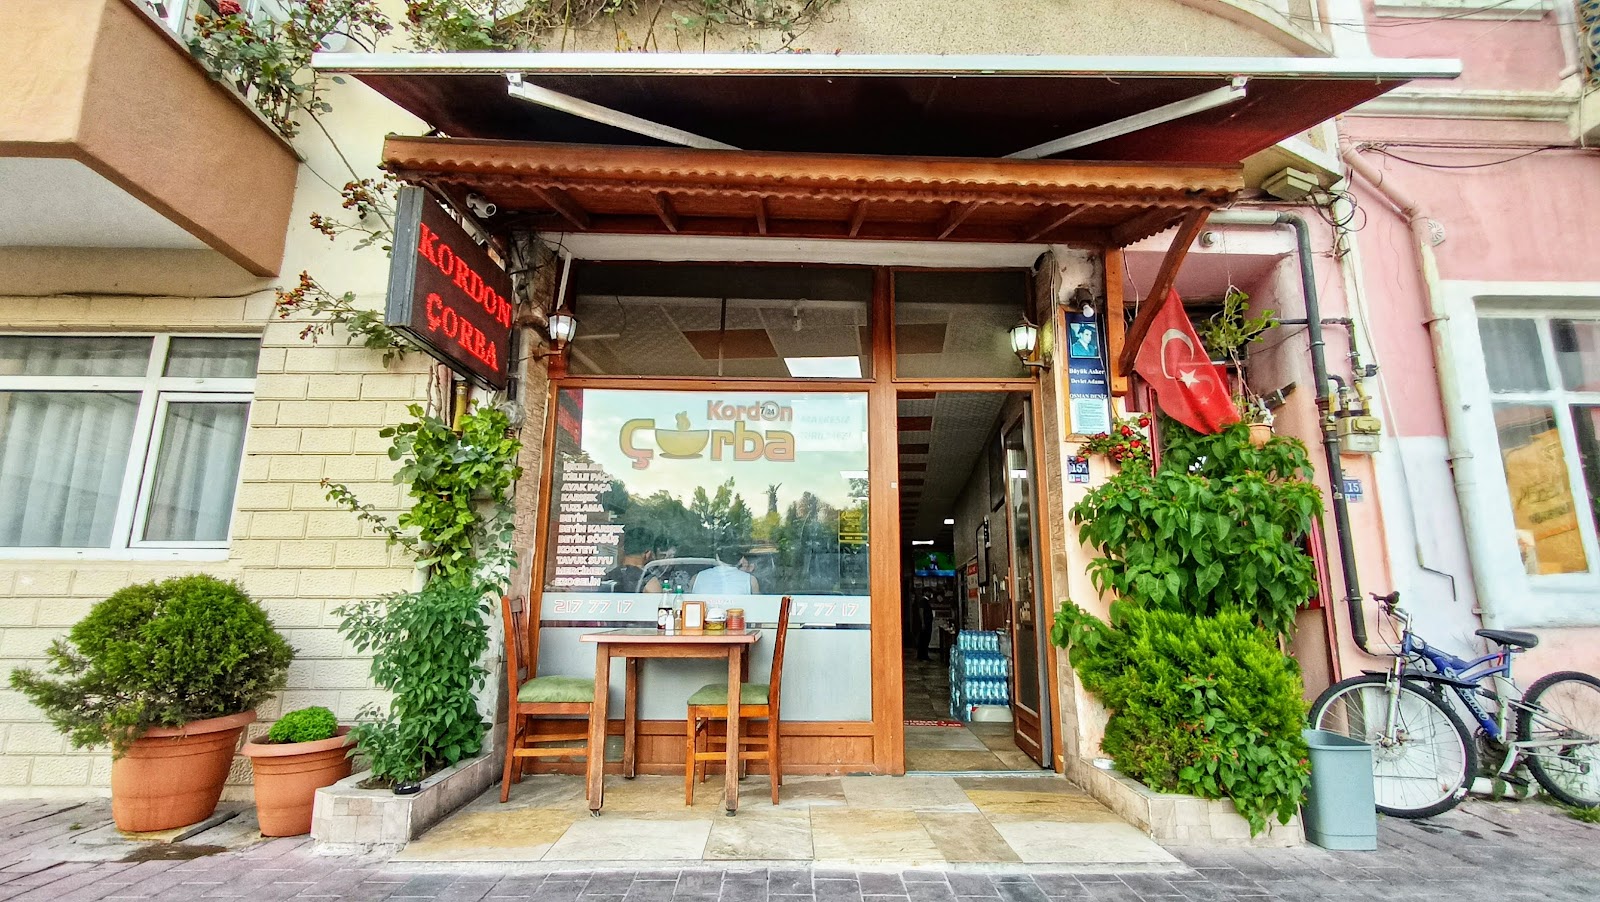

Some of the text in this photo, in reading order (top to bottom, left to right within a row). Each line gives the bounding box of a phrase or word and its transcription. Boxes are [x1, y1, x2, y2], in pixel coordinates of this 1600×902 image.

[418, 223, 512, 328] KORDON
[427, 293, 498, 371] ÇORBA
[563, 472, 614, 483] KELLE PAÇA
[561, 483, 612, 493] AYAK PAÇA
[1347, 482, 1360, 493] 15
[560, 503, 605, 513] TUZLAMA
[560, 512, 588, 523] BEYİN
[558, 523, 587, 533] BEYİN
[557, 533, 586, 544] BEYİN
[556, 545, 599, 555] KOKTEYL
[555, 555, 614, 565] TAVUK SUYU
[555, 565, 607, 576] MERCİMEK
[554, 575, 602, 587] EZOGELİN
[553, 600, 633, 614] 217 77 17
[813, 602, 836, 616] 77
[842, 602, 860, 617] 17
